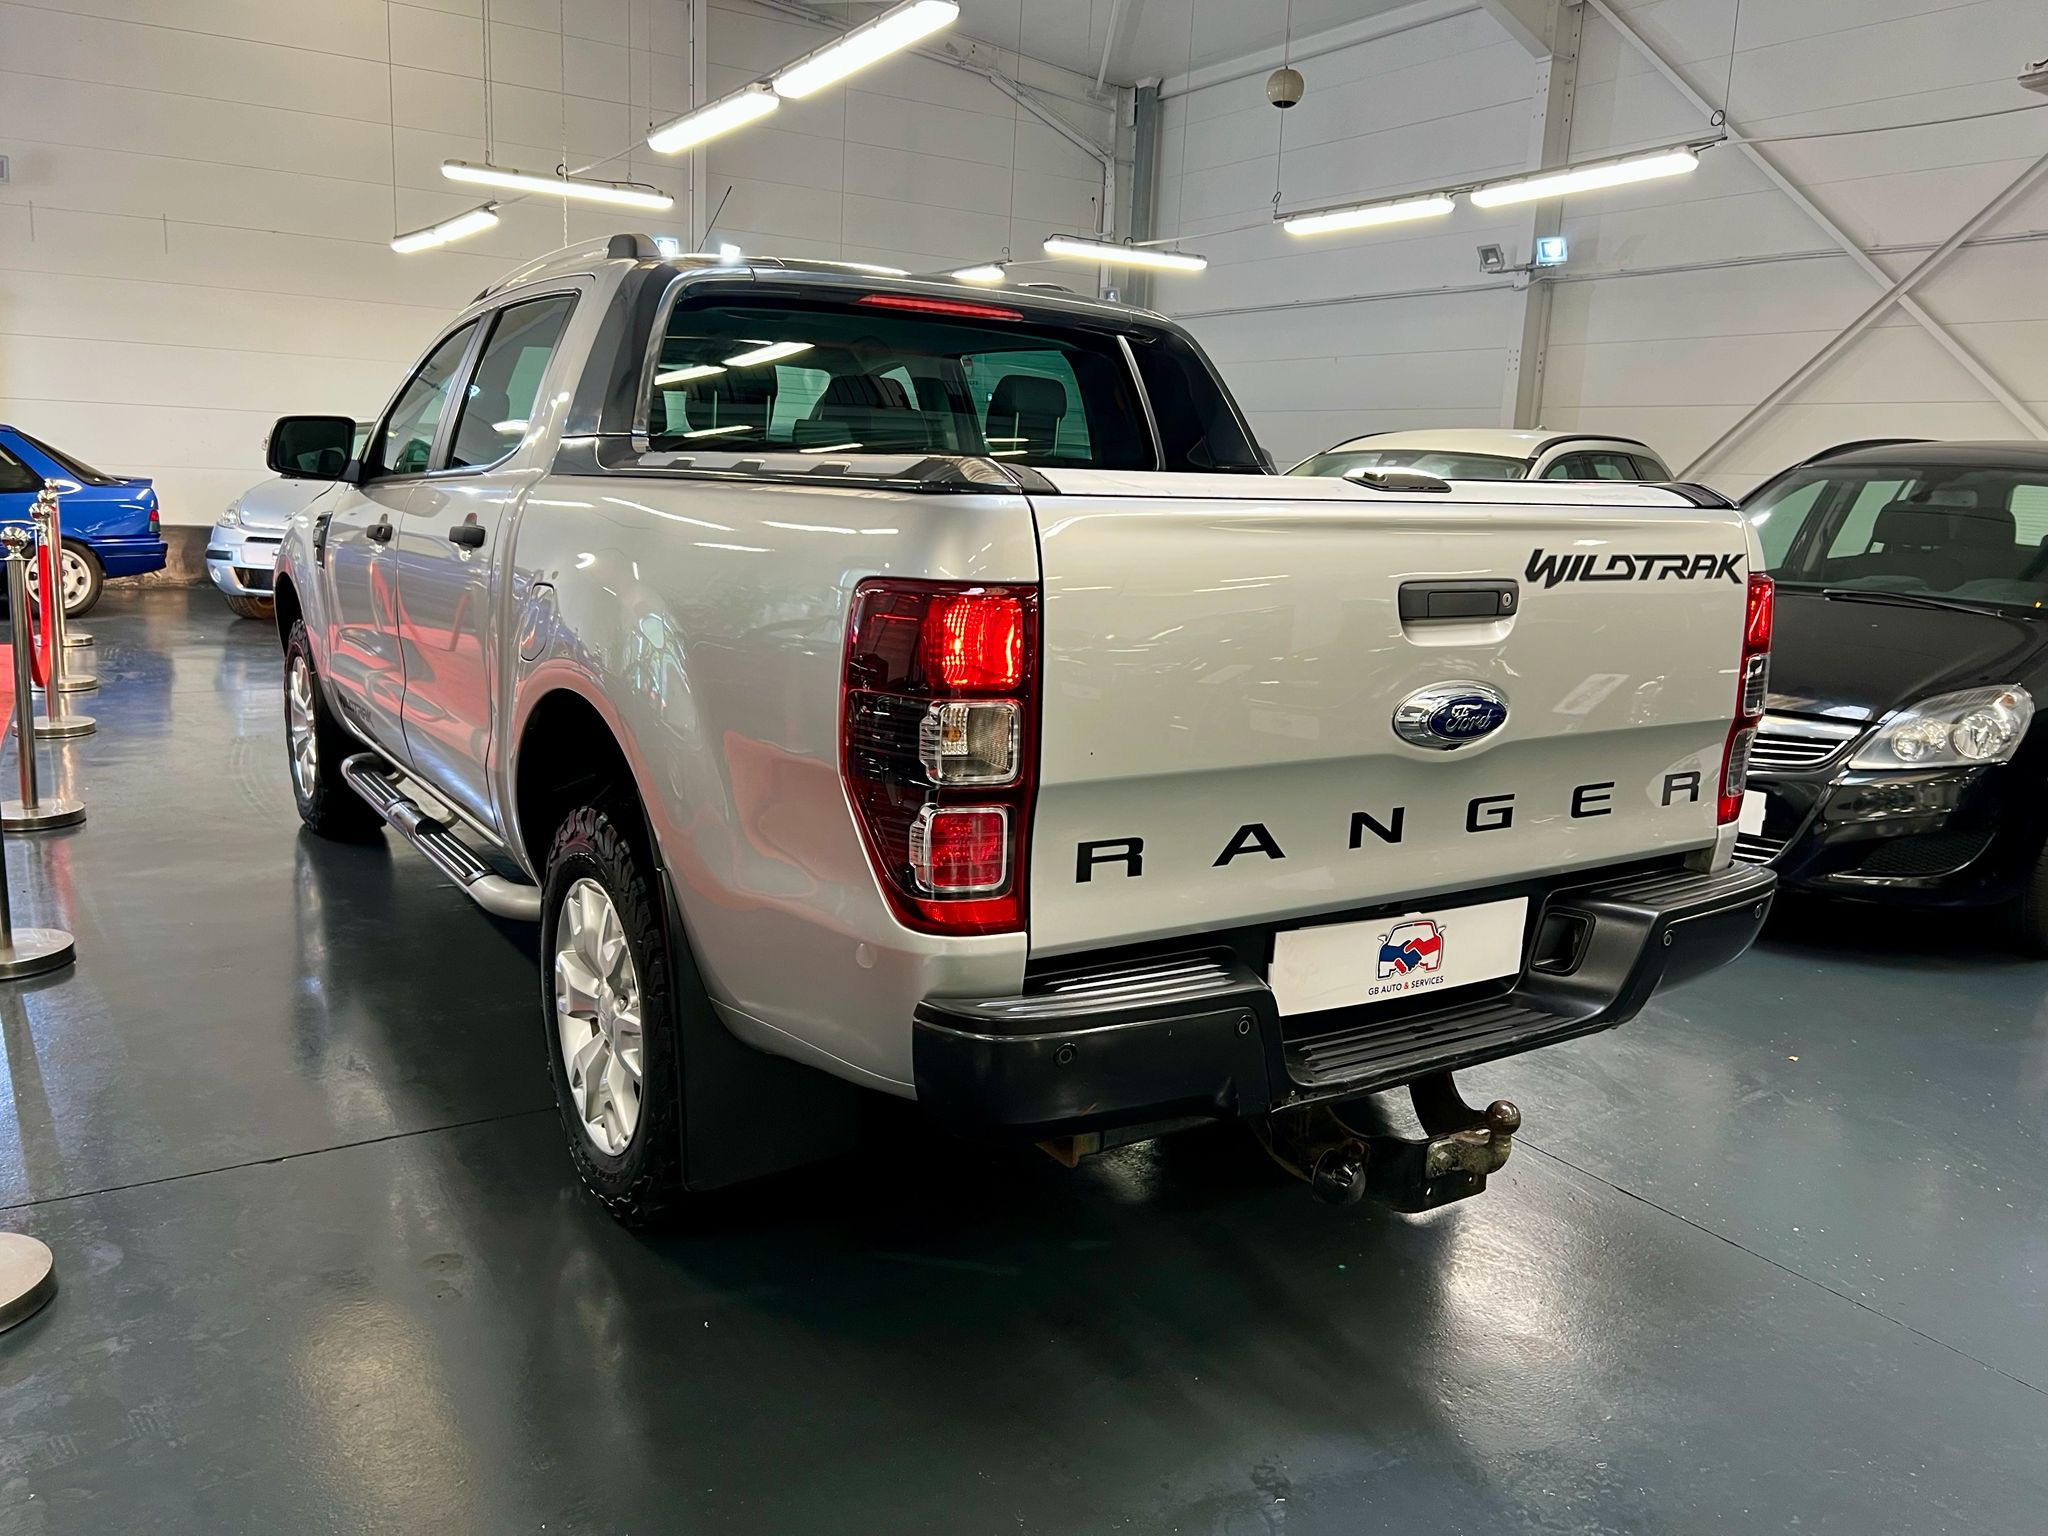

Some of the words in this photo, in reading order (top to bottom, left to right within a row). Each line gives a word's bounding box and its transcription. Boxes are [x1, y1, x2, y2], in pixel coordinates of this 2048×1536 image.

[1524, 548, 1746, 589] WILDTRAK
[1446, 703, 1493, 733] Ford
[1075, 771, 1702, 884] RANGER
[1368, 987, 1379, 996] GB
[1380, 983, 1403, 994] AUTO
[1403, 981, 1409, 990] &
[1411, 975, 1444, 989] SERVICES
